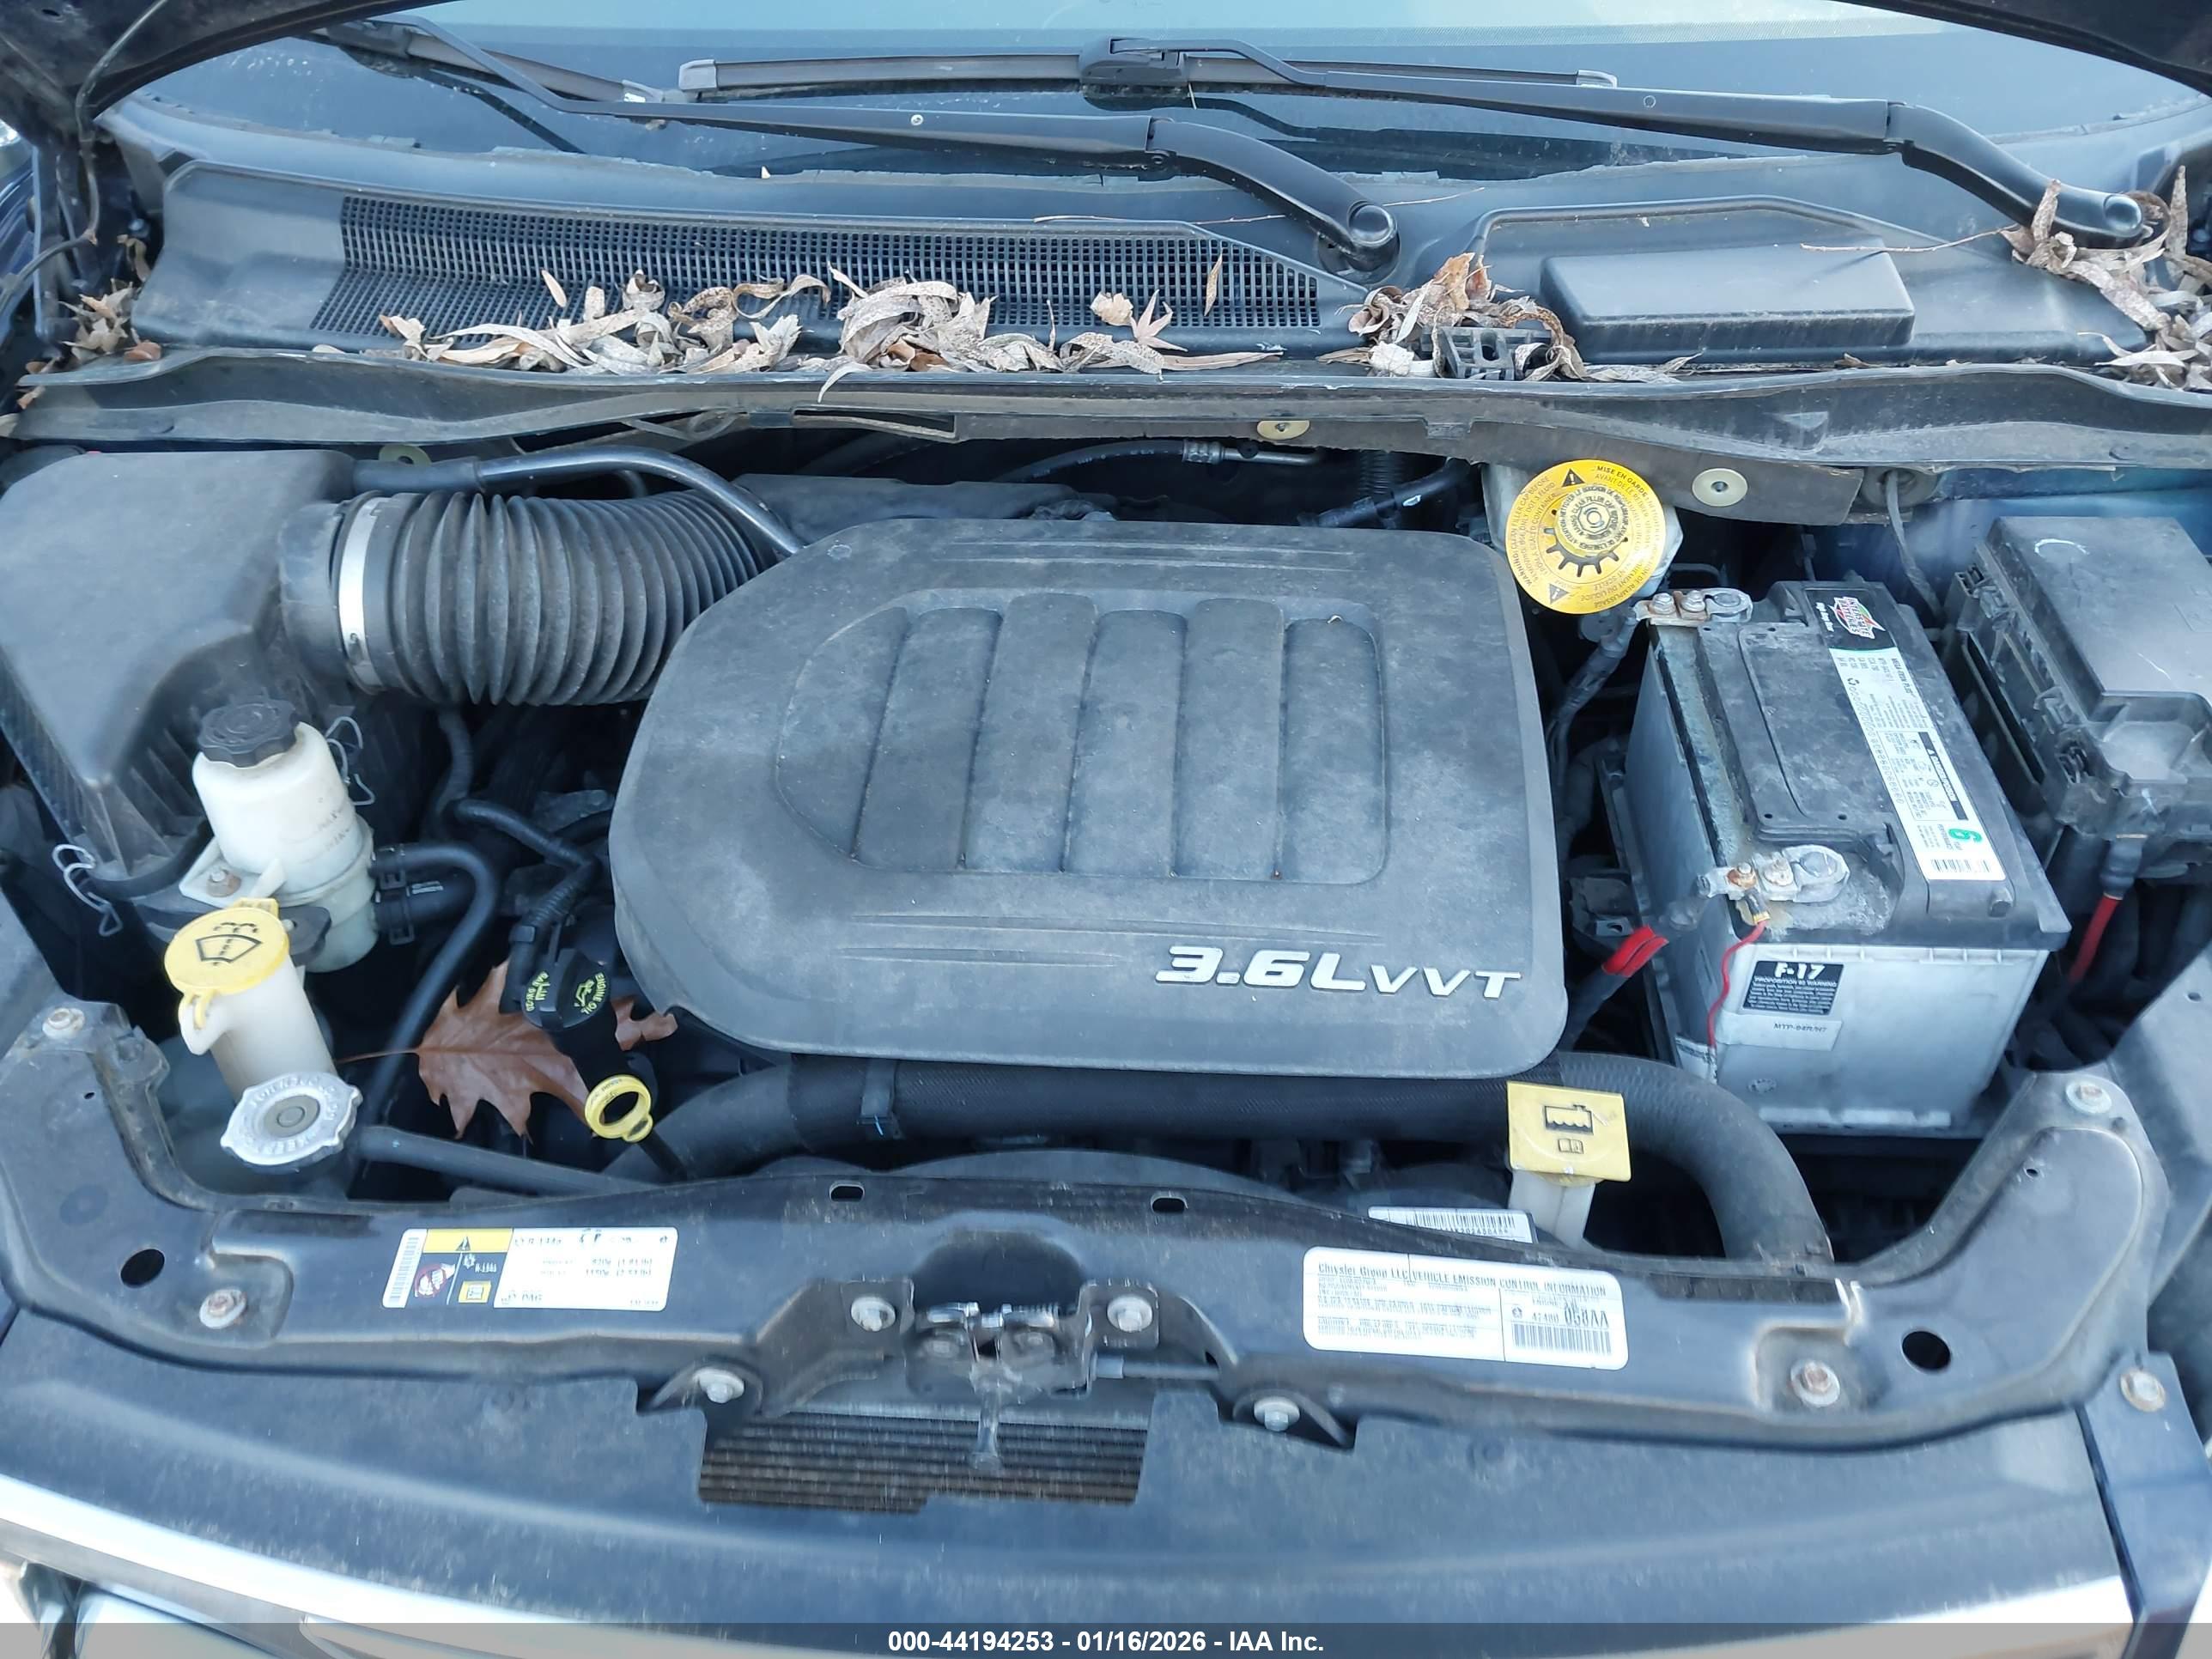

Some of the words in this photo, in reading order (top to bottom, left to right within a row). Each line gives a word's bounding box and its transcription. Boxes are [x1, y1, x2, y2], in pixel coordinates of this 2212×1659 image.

[1596, 465, 1615, 474] MISE
[1616, 471, 1626, 480] EN
[1847, 598, 1870, 638] INTERSTATE
[1948, 828, 1983, 844] 6
[1155, 945, 1367, 992] 3.6L
[1370, 964, 1522, 1000] VVT
[1775, 962, 1826, 980] F-17
[592, 972, 607, 1003] ENGINE
[1754, 975, 1797, 986] PROPOSITION
[580, 1001, 599, 1015] OIL
[1318, 1262, 1357, 1277] Chrysler
[1359, 1266, 1388, 1279] Group
[1390, 1267, 1409, 1280] LLC
[1411, 1271, 1450, 1285] VEHICLE
[1452, 1274, 1497, 1287] EMISSION
[1499, 1277, 1540, 1291] CONTROL
[1543, 1281, 1607, 1297] INFORMATION
